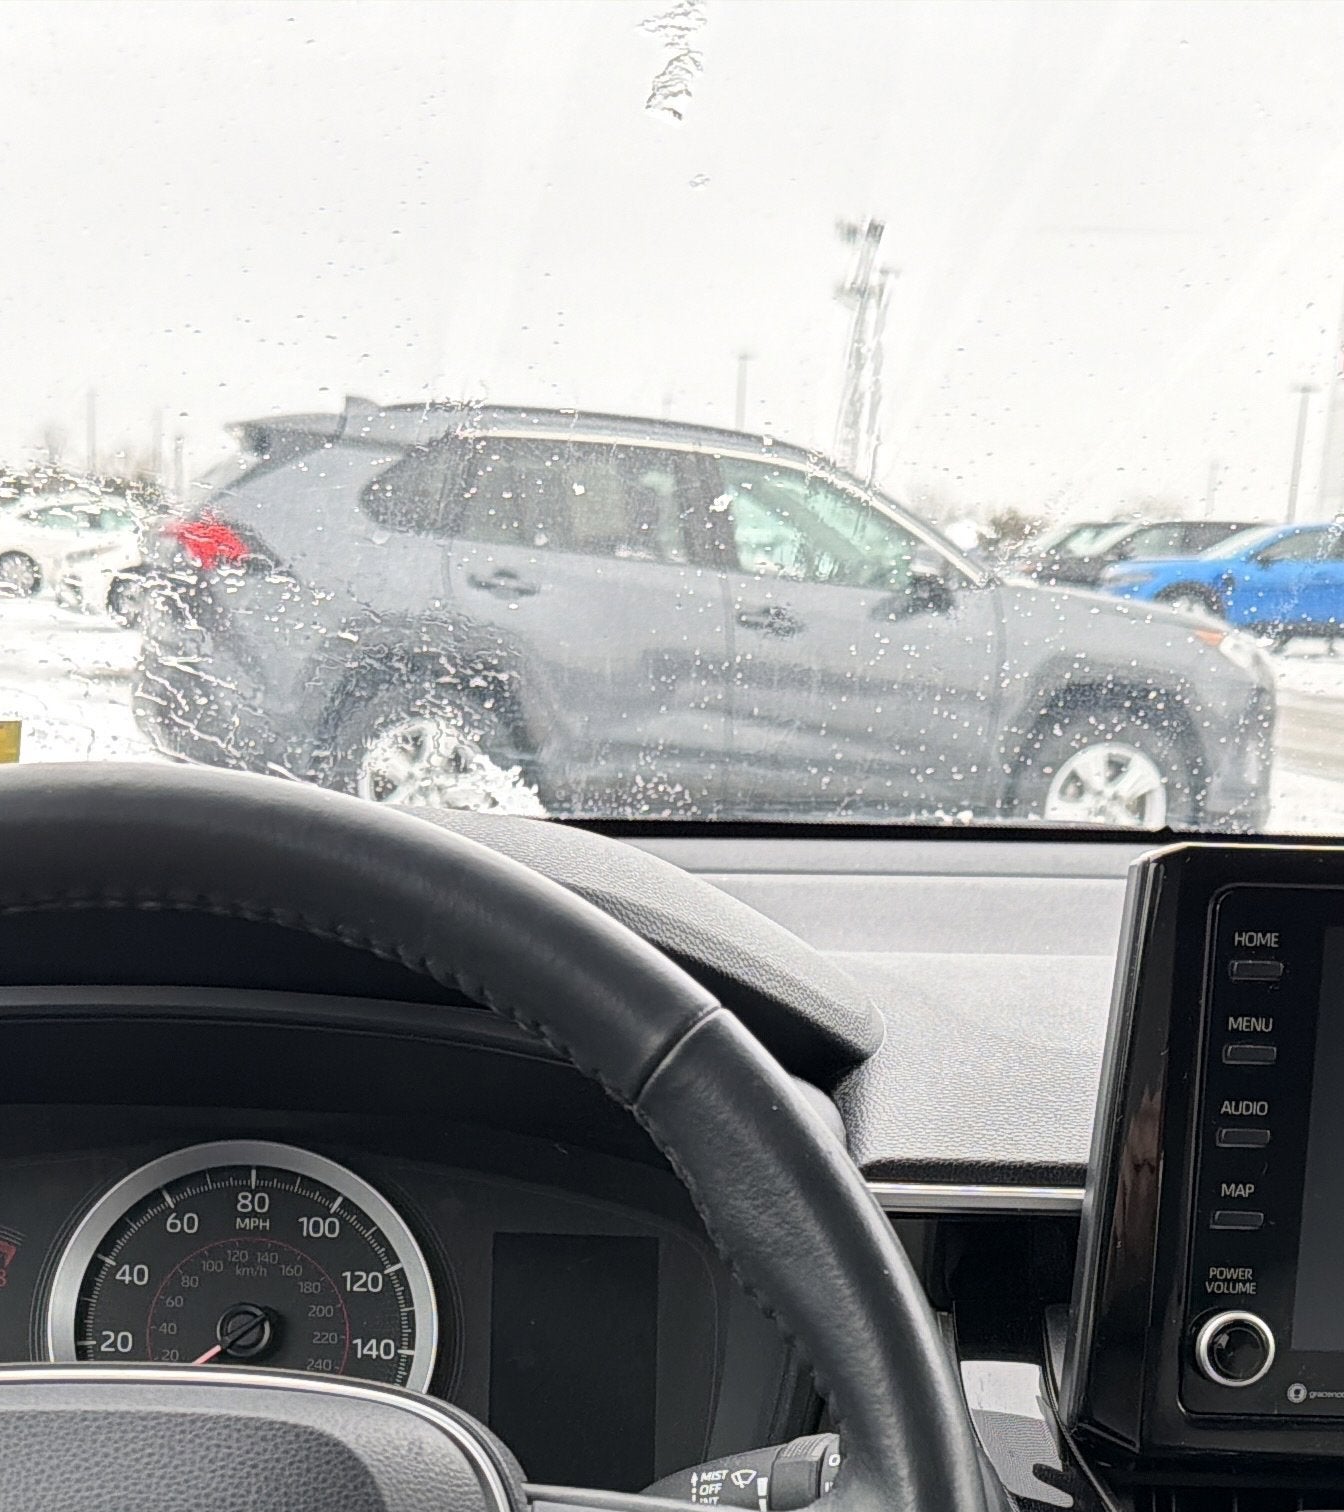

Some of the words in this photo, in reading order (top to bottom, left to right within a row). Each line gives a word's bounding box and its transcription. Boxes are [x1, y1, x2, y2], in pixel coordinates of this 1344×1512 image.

[1234, 932, 1280, 949] HOME
[1227, 1016, 1274, 1033] MENU
[1220, 1100, 1269, 1117] AUDIO
[1220, 1182, 1255, 1199] MAP
[236, 1192, 270, 1214] 80
[165, 1212, 199, 1235] 60
[235, 1217, 271, 1232] MPH
[297, 1216, 341, 1239] 100
[226, 1250, 249, 1263] 120
[256, 1251, 279, 1265] 140
[201, 1260, 225, 1273] 100
[234, 1265, 268, 1278] km/h
[280, 1264, 304, 1278] 160
[114, 1264, 150, 1287] 40
[1208, 1267, 1254, 1282] POWER
[180, 1276, 199, 1288] 80
[298, 1281, 321, 1294] 180
[342, 1271, 385, 1294] 120
[1204, 1281, 1257, 1295] VOLUME
[165, 1296, 184, 1308] 60
[307, 1305, 334, 1318] 200
[158, 1322, 177, 1335] 40
[100, 1331, 134, 1354] 20
[312, 1332, 338, 1344] 220
[161, 1350, 179, 1362] 20
[352, 1338, 396, 1361] 140
[306, 1359, 333, 1372] 240
[700, 1469, 730, 1482] MIST
[699, 1482, 723, 1496] OFF
